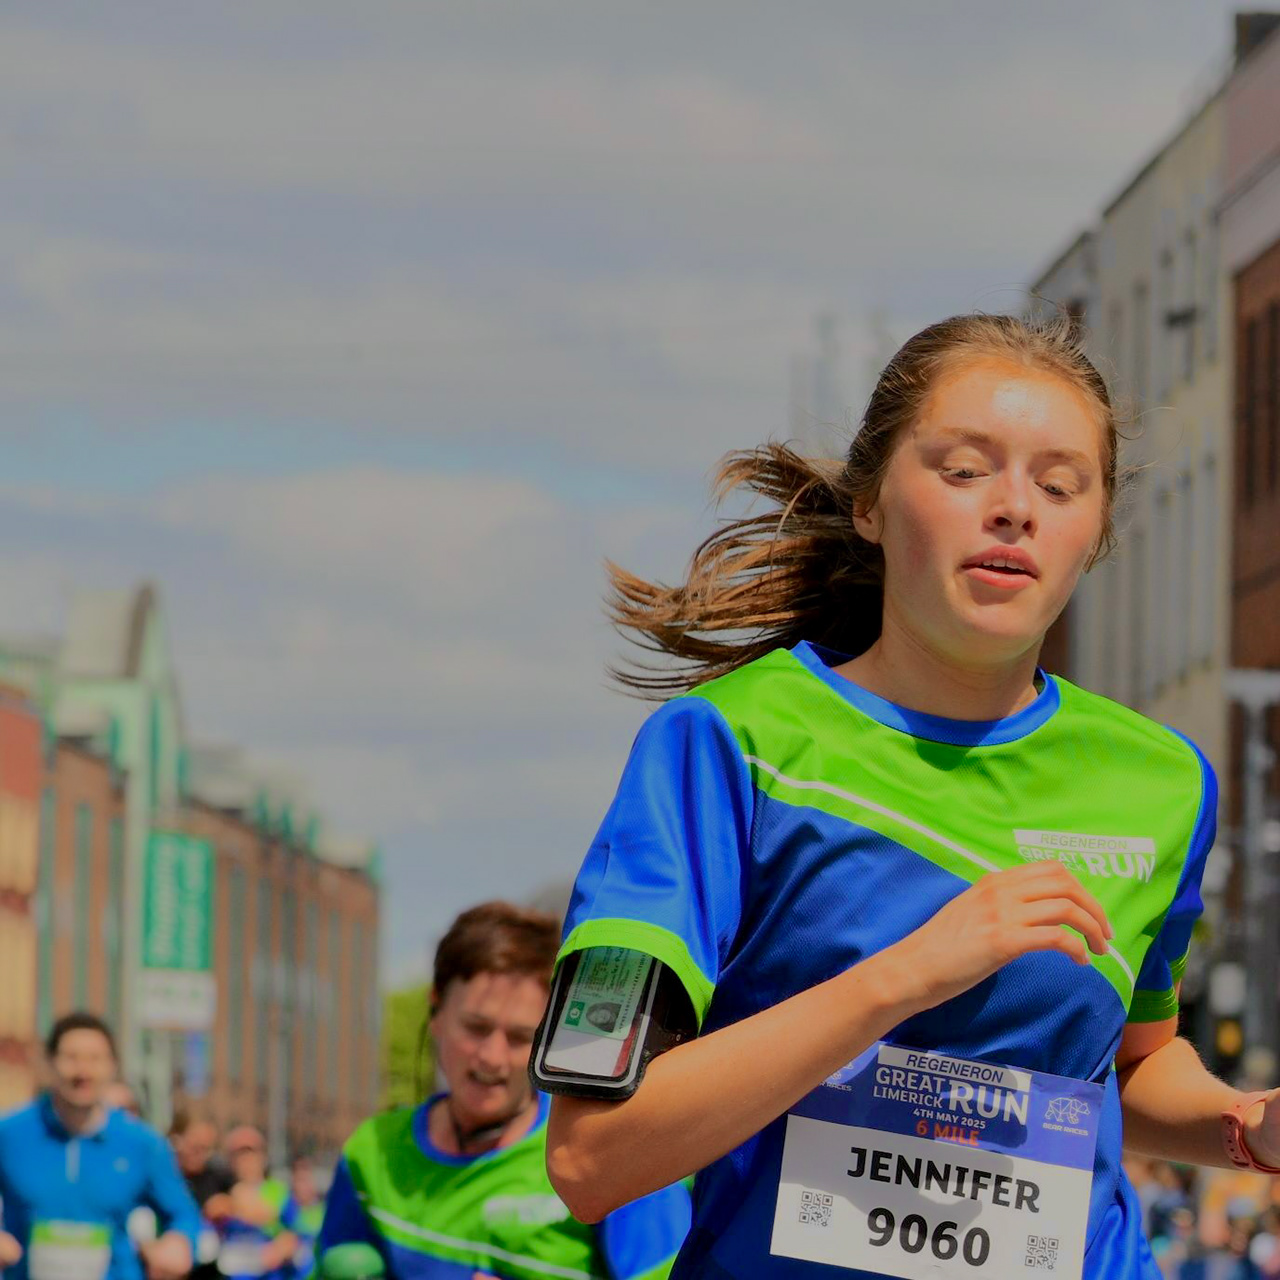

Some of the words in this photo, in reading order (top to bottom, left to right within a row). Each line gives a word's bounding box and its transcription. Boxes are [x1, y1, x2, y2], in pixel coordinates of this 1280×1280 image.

[1041, 833, 1128, 850] REGENERON
[1083, 852, 1156, 883] RUN
[876, 1067, 946, 1094] GREAT
[906, 1054, 1003, 1083] REGENERON
[873, 1086, 942, 1109] LIMERICK
[949, 1079, 1029, 1126] RUN
[913, 1108, 934, 1119] 4TH
[936, 1113, 959, 1124] MAY
[961, 1117, 986, 1129] 2025
[916, 1119, 928, 1136] 6
[934, 1123, 980, 1147] MILE
[847, 1147, 1040, 1214] JENNIFER
[867, 1207, 990, 1267] 9060
